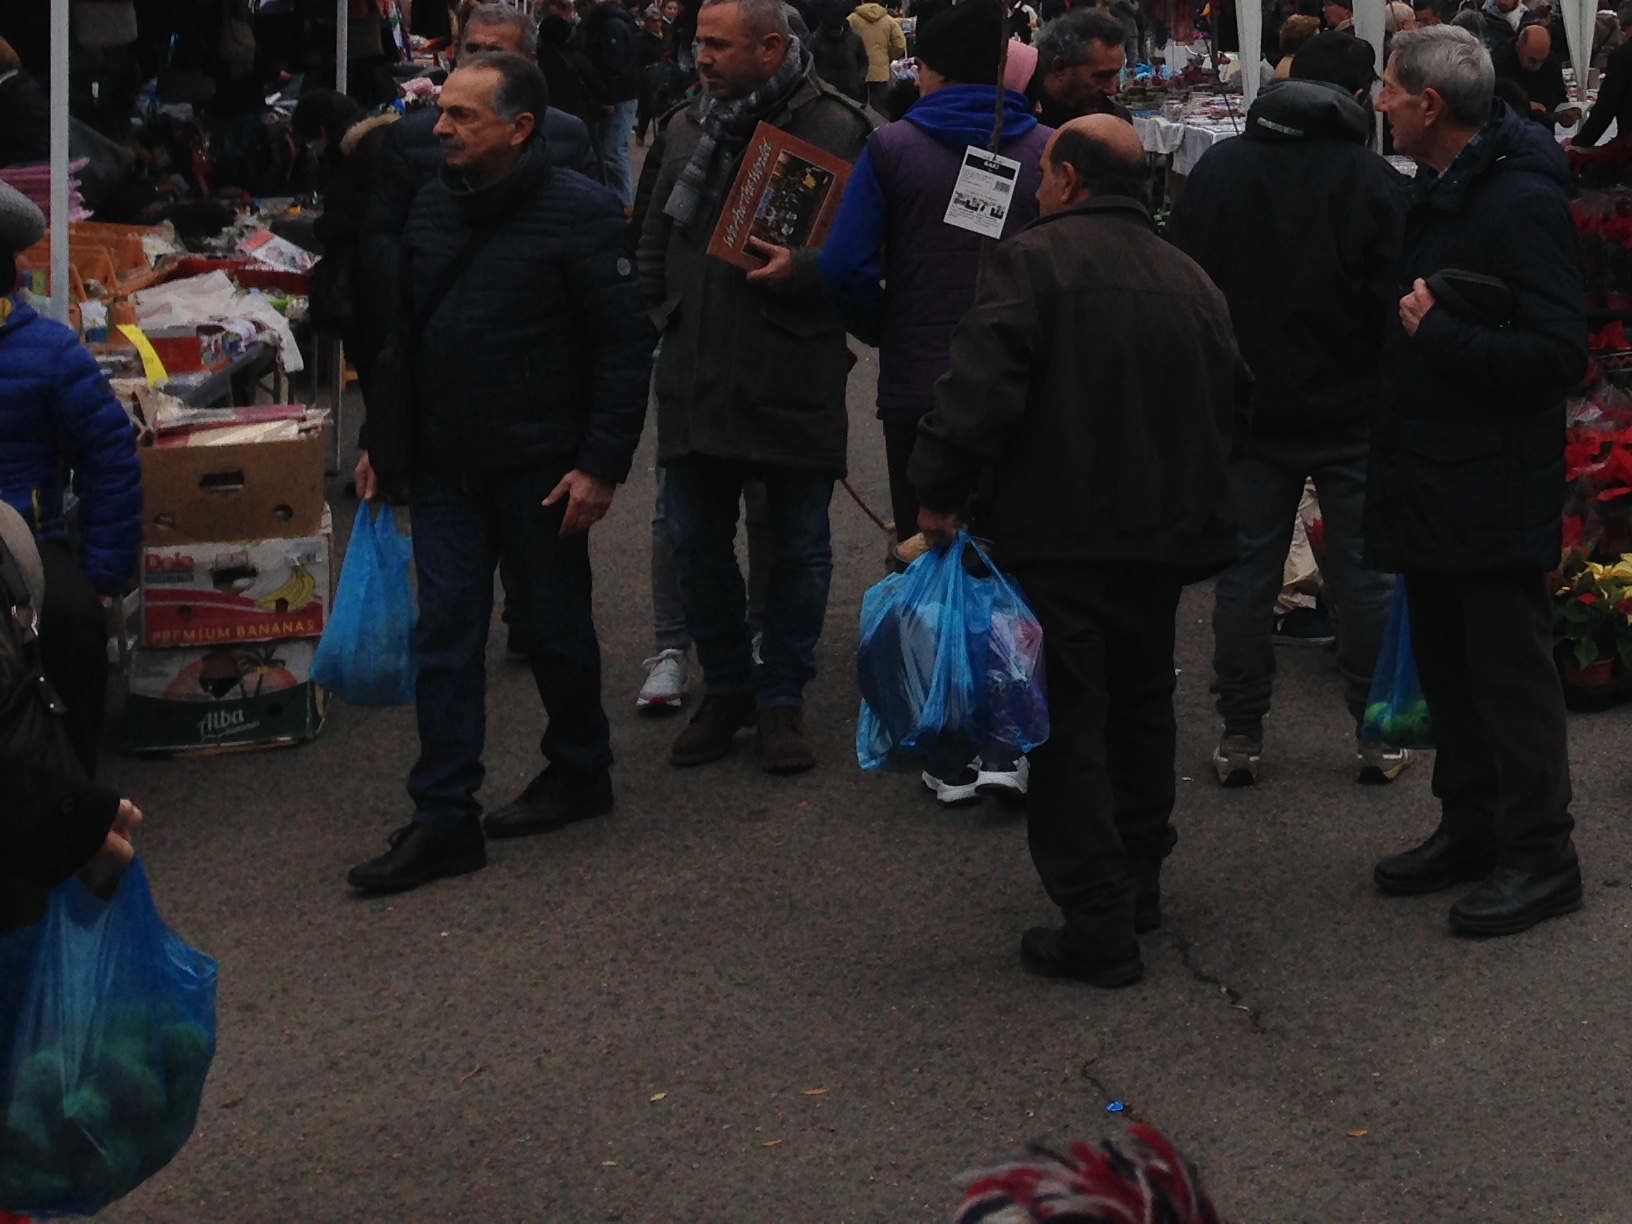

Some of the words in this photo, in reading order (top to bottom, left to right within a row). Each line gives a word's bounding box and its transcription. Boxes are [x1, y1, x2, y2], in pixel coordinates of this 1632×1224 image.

[152, 627, 230, 644] PREMIUM
[236, 618, 315, 638] BANANAS
[197, 708, 246, 742] Alba
